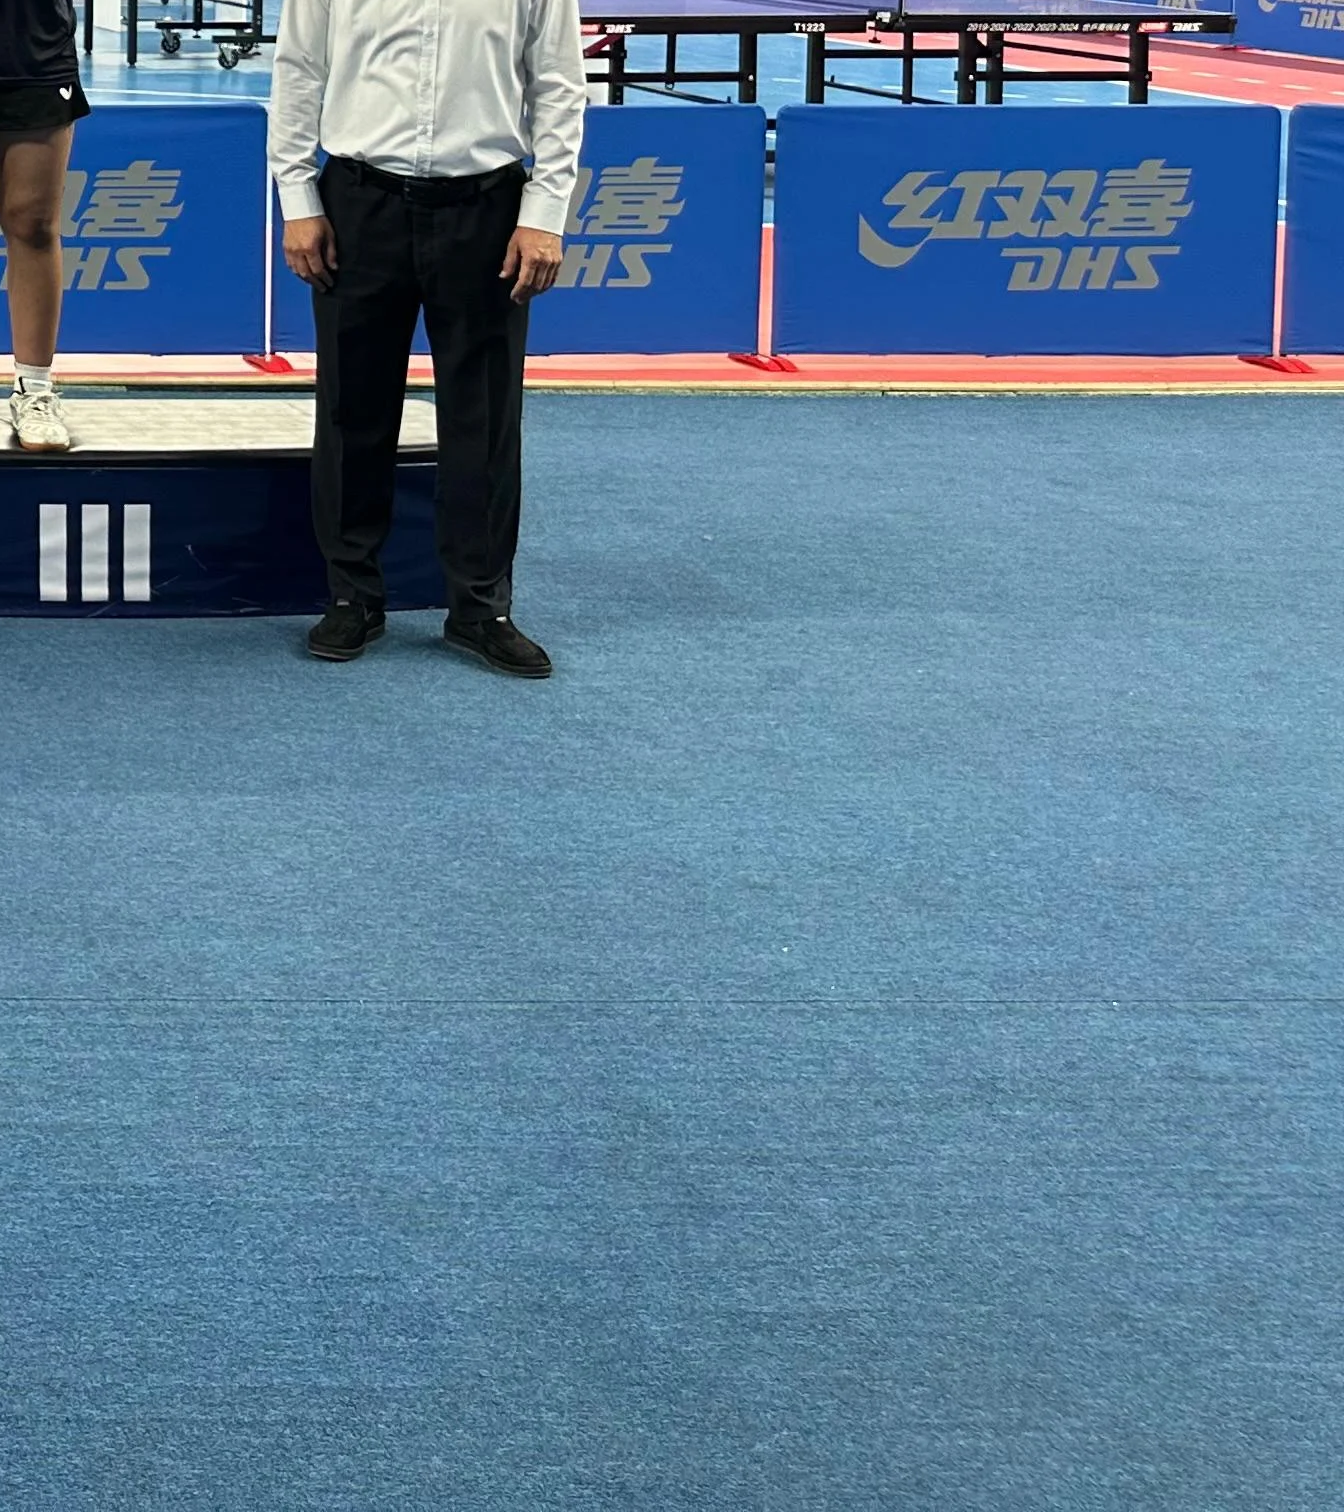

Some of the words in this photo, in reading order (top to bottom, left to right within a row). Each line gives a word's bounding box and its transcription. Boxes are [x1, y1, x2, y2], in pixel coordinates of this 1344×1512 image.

[604, 23, 636, 34] DHS
[793, 22, 825, 32] T1223
[1172, 22, 1204, 33] DHS
[859, 158, 1195, 268] 红双喜
[553, 243, 673, 288] HS
[999, 245, 1182, 291] DHS
[39, 503, 152, 602] III
